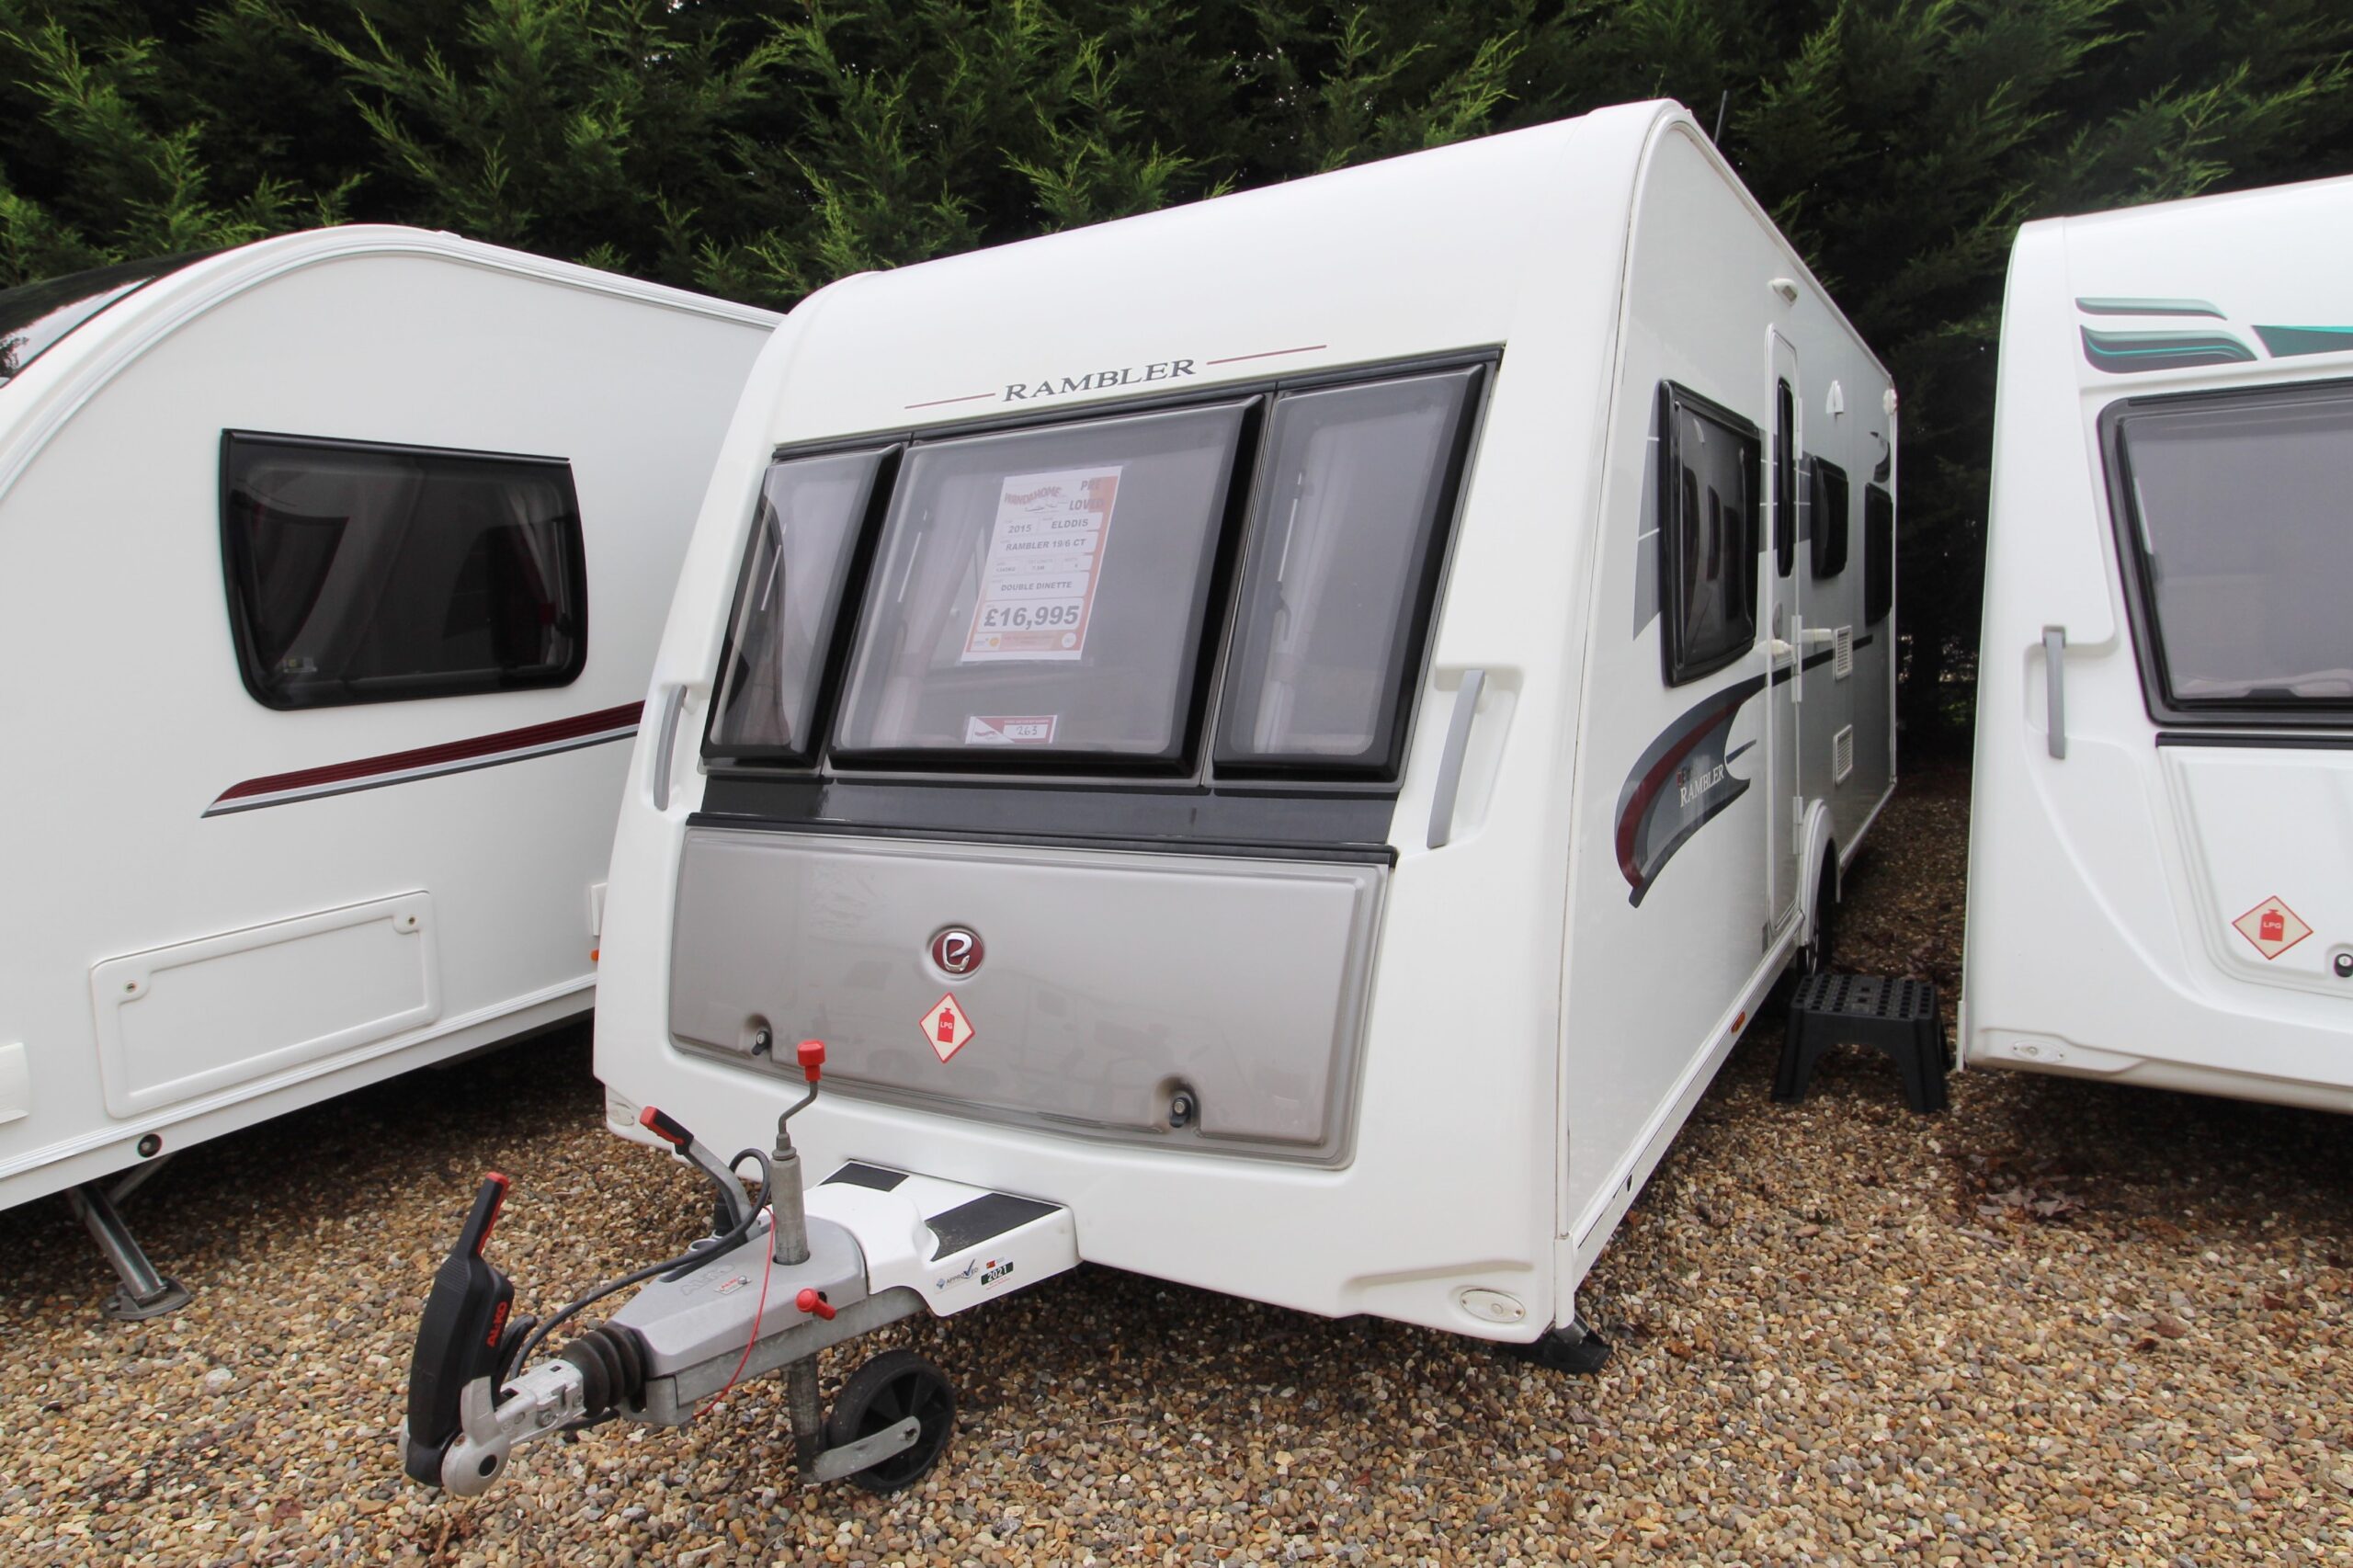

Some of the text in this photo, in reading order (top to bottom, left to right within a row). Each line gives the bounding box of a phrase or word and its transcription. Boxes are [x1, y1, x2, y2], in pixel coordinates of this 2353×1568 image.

[1002, 358, 1197, 402] RAMBLER
[1007, 524, 1032, 534] 2015
[1051, 518, 1089, 529] ELDDIS
[1006, 540, 1050, 551] RAMBLER
[1073, 539, 1087, 547] CT
[1001, 581, 1073, 592] DOUBLE DINETTE
[983, 605, 1080, 631] £16,995
[1016, 725, 1038, 736] 263
[1679, 764, 1724, 809] RAMBLER
[2263, 921, 2282, 929] LPG
[940, 1021, 953, 1029] LPG
[987, 1265, 1008, 1282] 2021
